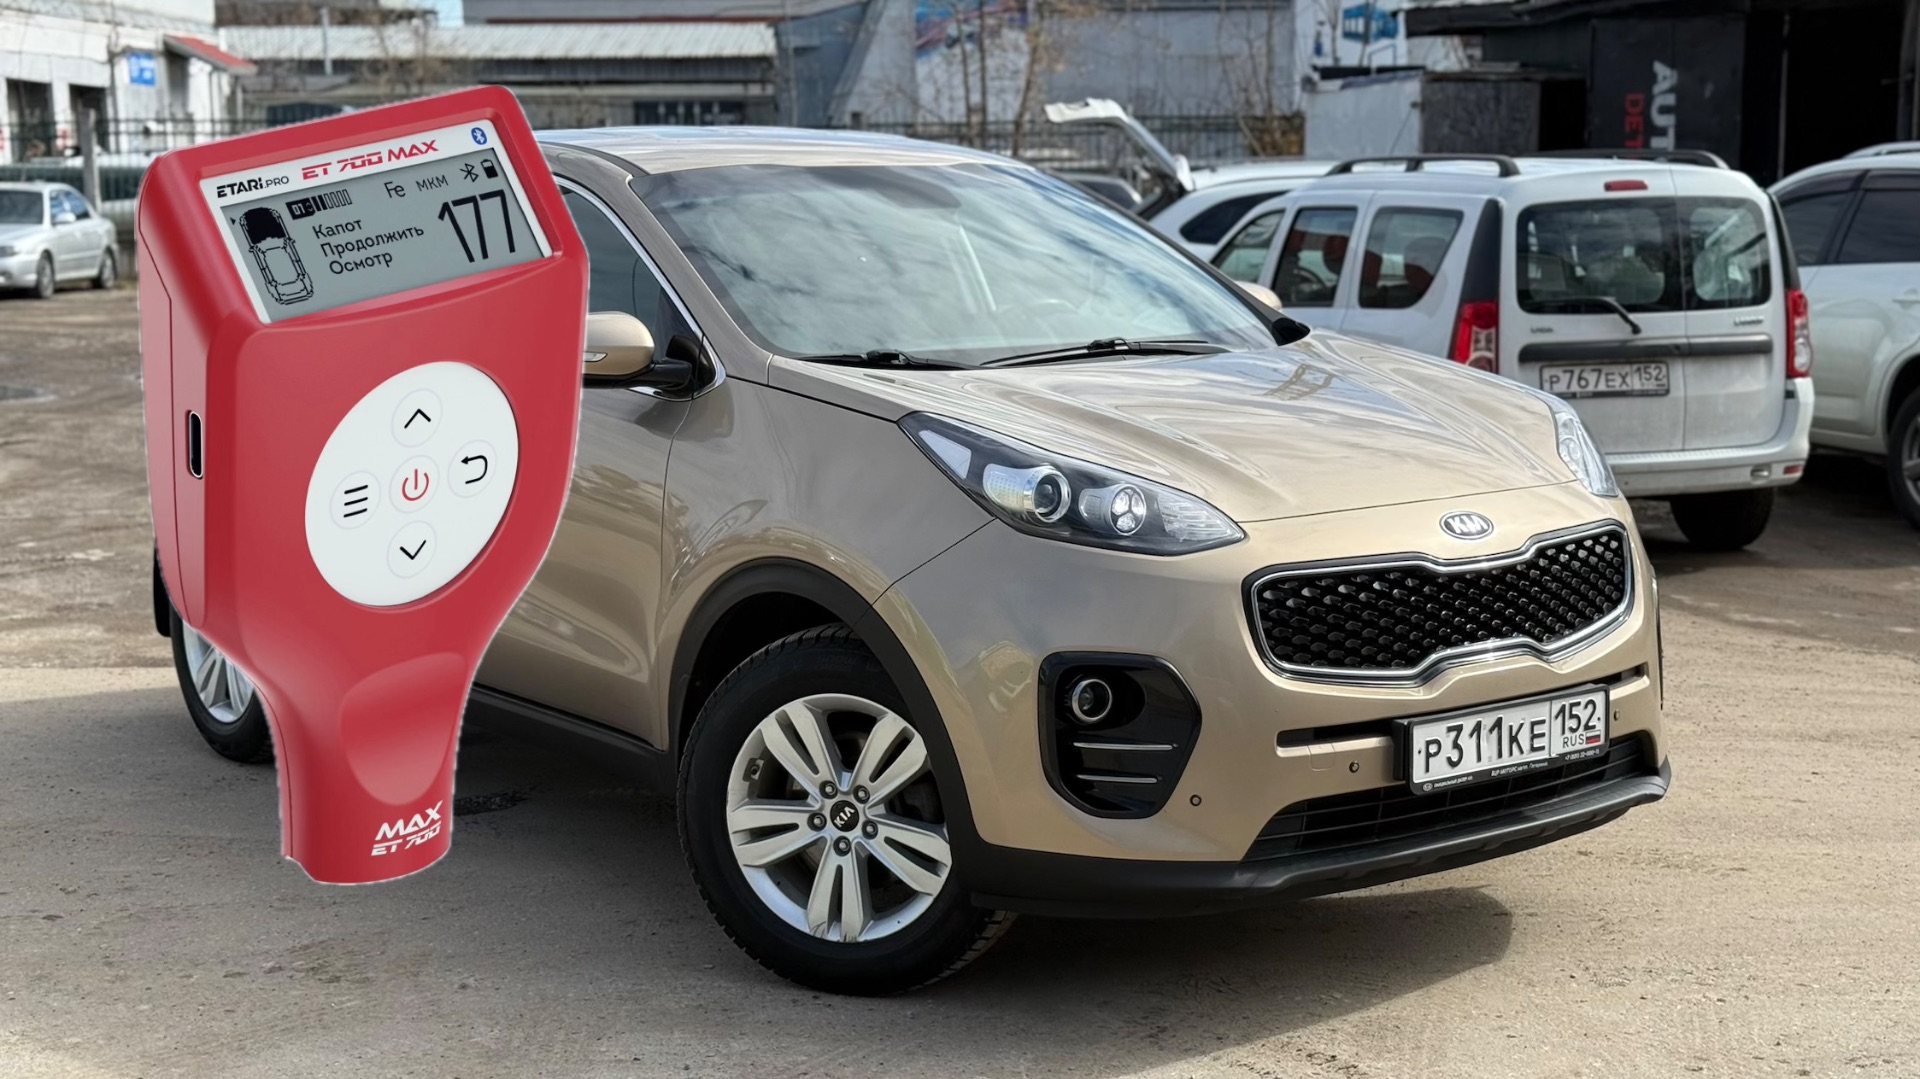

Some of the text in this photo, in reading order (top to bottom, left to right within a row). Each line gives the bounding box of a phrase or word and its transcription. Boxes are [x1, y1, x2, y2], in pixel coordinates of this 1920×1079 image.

[1650, 60, 1678, 152] AUT
[1625, 93, 1644, 149] DET
[301, 139, 439, 180] ET 700 MAX
[384, 181, 406, 198] Fe
[312, 219, 363, 239] Капот
[438, 189, 516, 263] 177
[320, 226, 425, 258] Продолжить
[329, 251, 393, 275] Осмотр
[1633, 365, 1663, 383] 152
[1445, 514, 1490, 535] KIA
[1554, 698, 1597, 736] 152
[1562, 733, 1585, 749] RUS
[375, 800, 443, 841] MAX
[833, 806, 856, 828] KIA
[371, 839, 403, 856] ET
